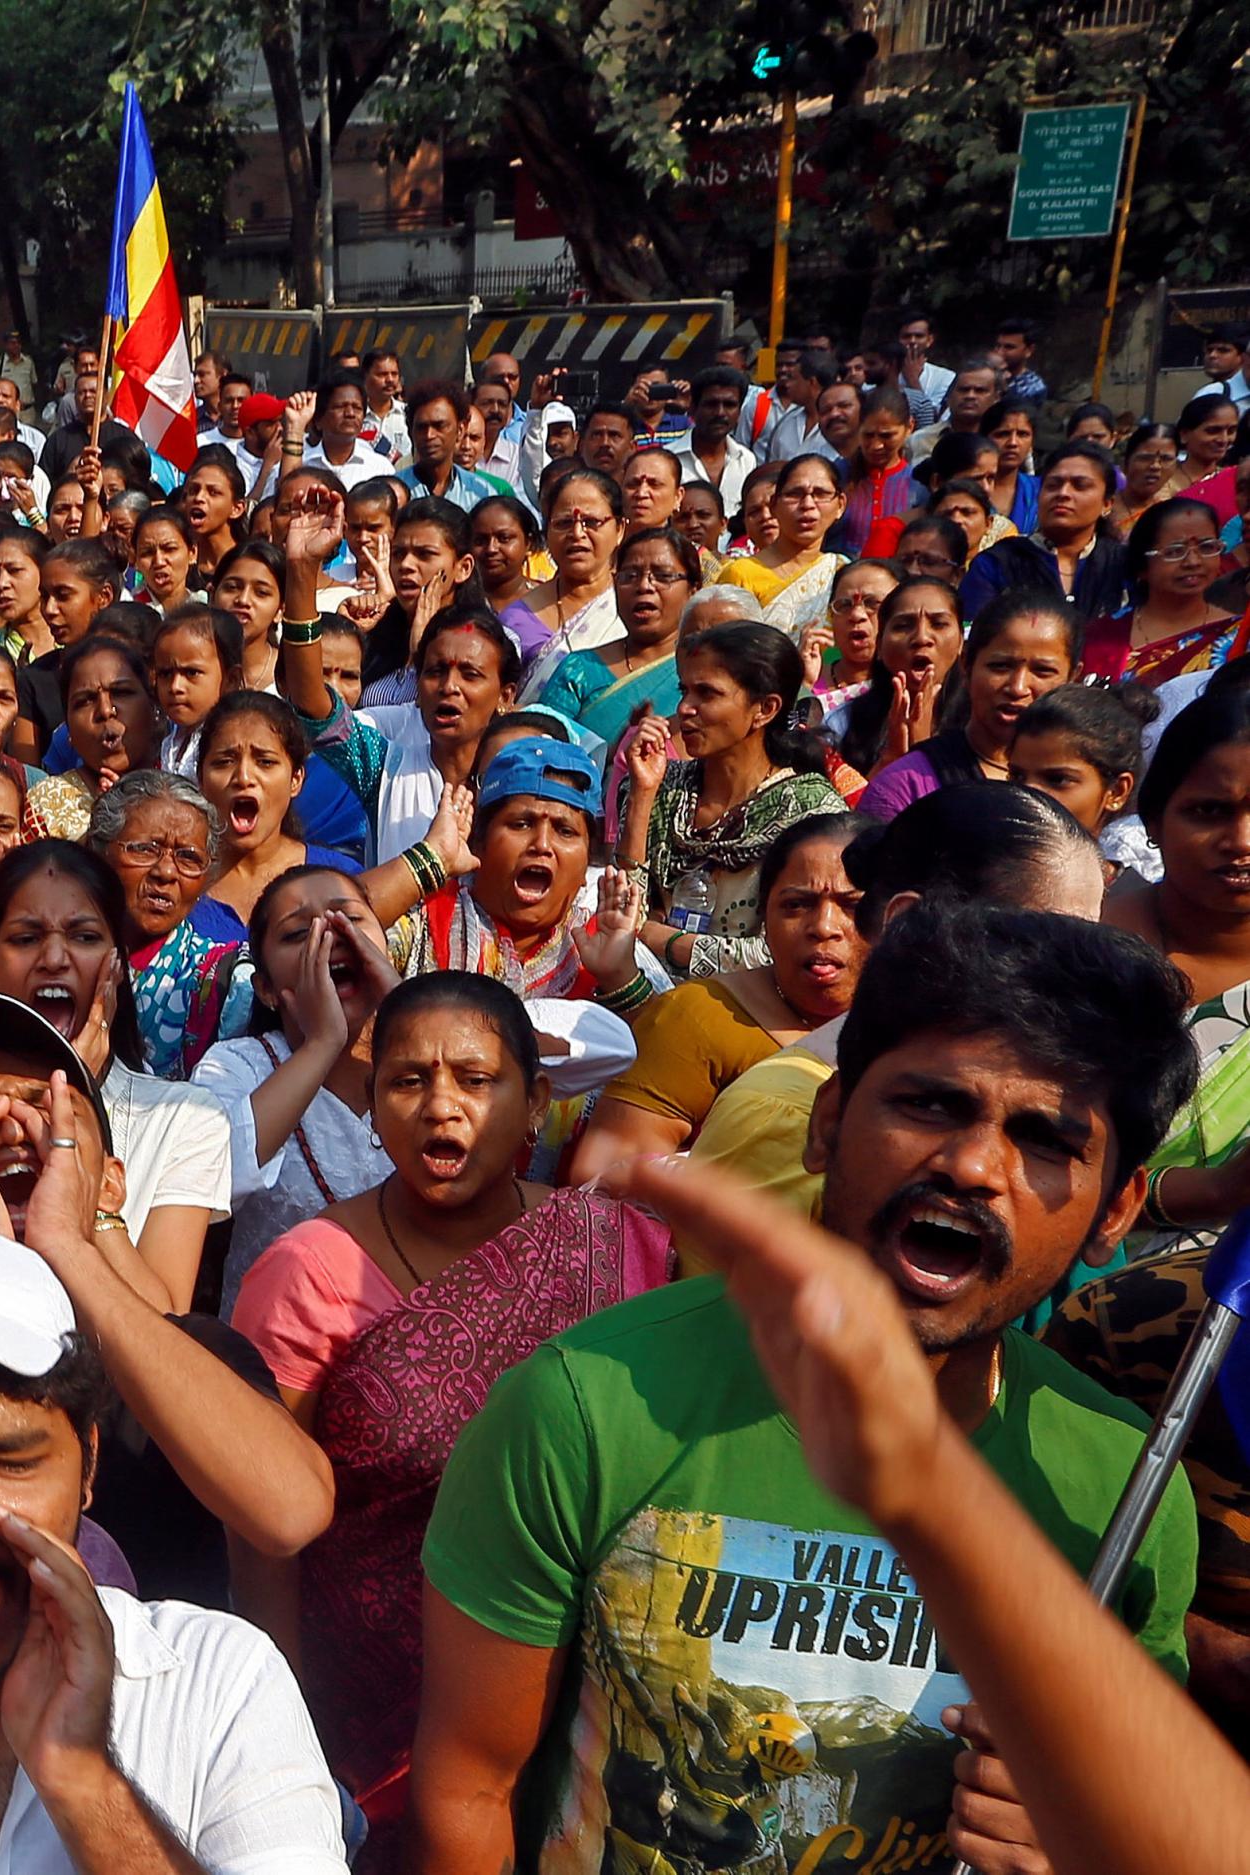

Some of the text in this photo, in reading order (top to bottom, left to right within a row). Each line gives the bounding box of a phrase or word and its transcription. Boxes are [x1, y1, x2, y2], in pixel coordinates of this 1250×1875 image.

[1018, 184, 1112, 198] GOVERDHAN DAS
[1042, 198, 1098, 209] KALANTRI
[1040, 211, 1081, 222] CHOWK
[793, 1540, 922, 1596] VALLE
[676, 1568, 961, 1675] UPRISIN
